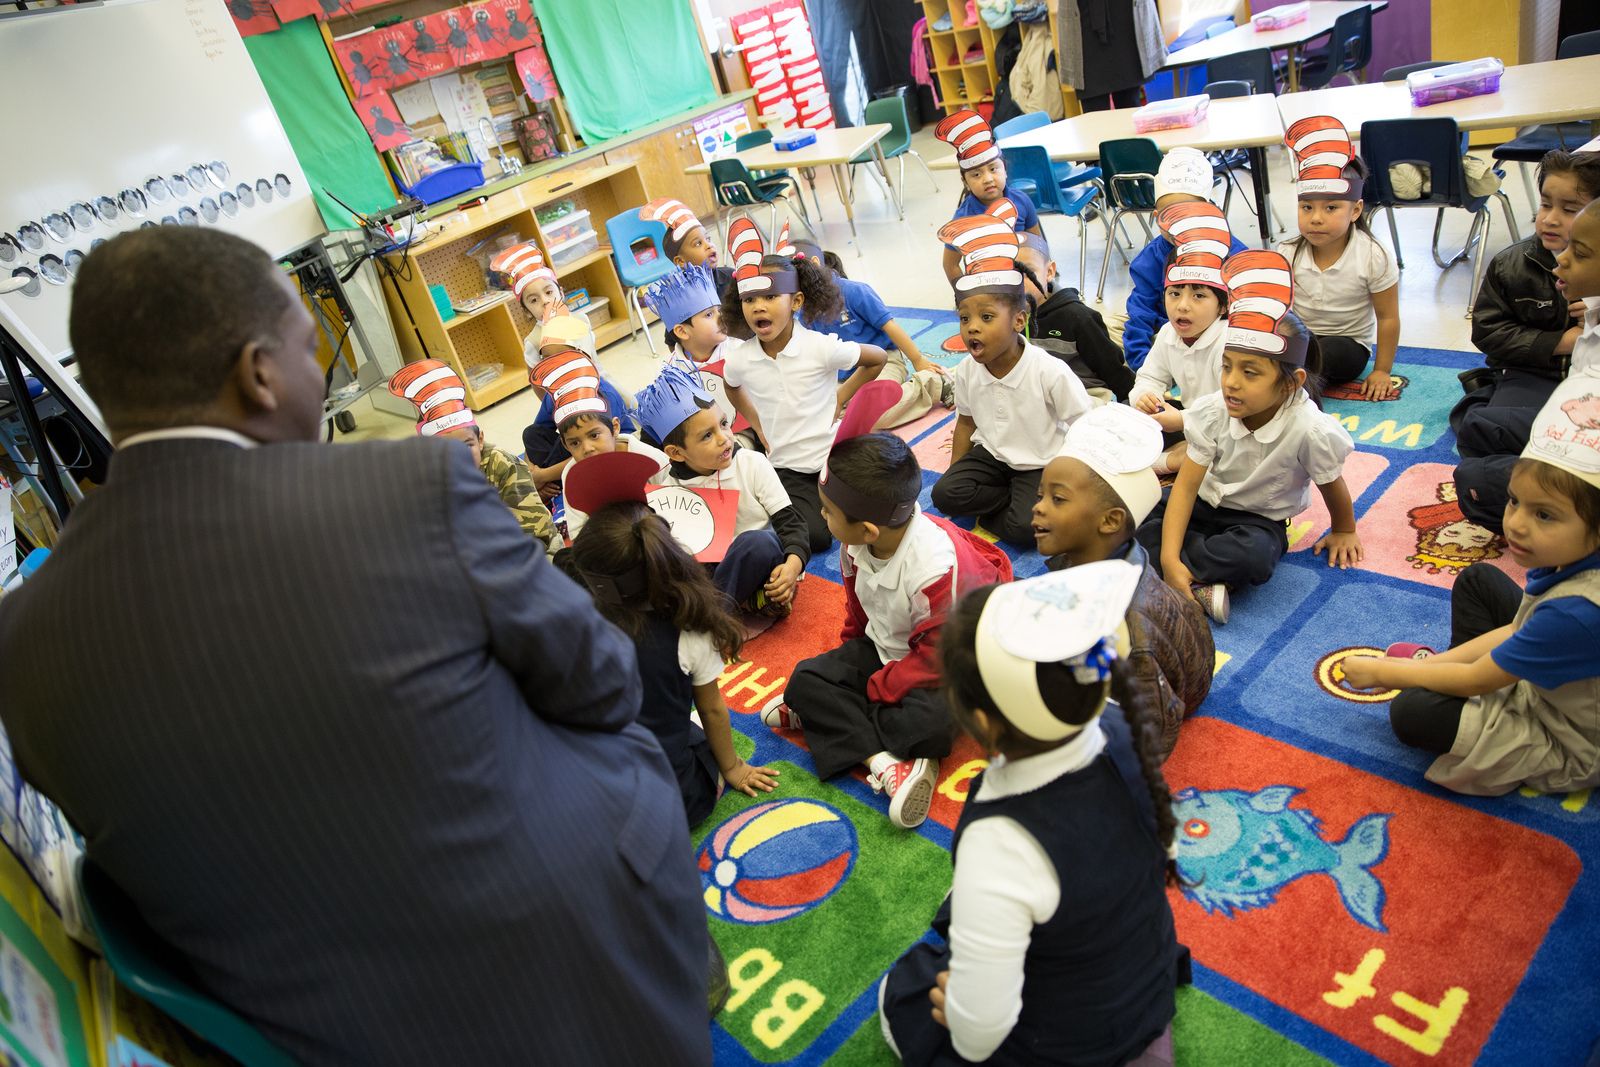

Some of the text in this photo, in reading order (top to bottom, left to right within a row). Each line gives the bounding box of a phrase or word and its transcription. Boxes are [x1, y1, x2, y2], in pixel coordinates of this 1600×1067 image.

[1179, 268, 1210, 280] Honorio
[725, 947, 827, 1050] Bb
[1322, 948, 1470, 1056] Ff
